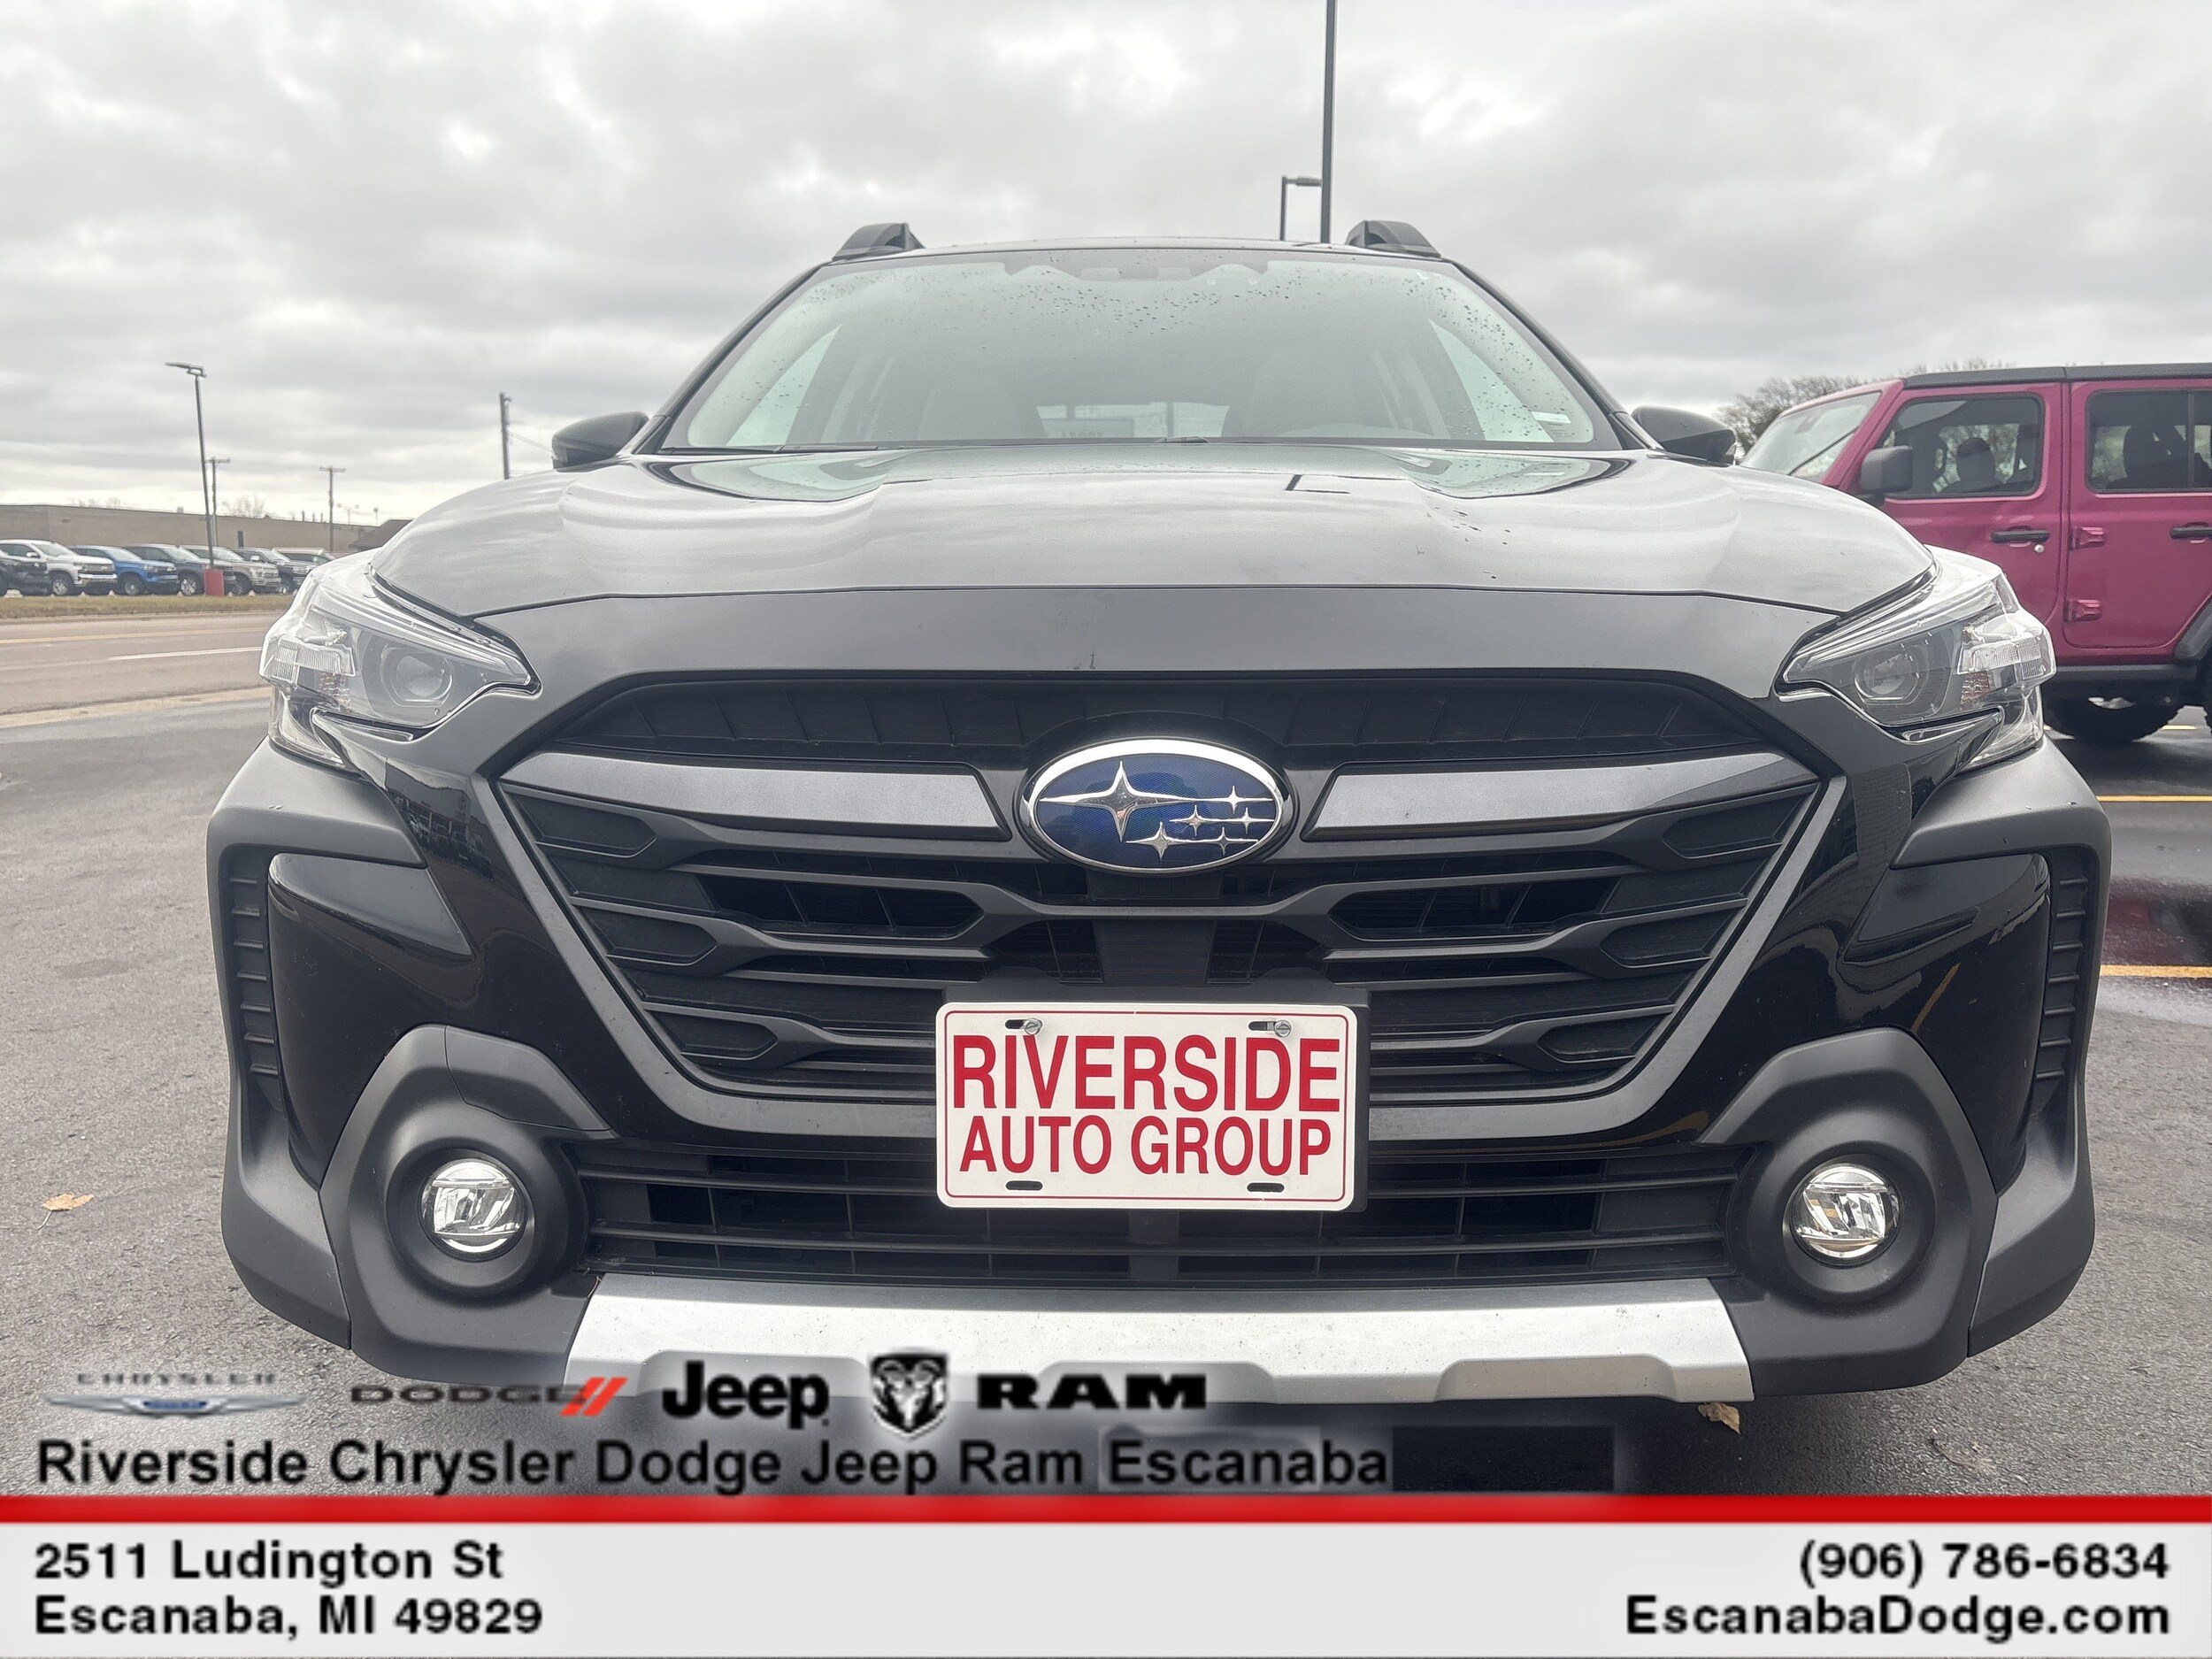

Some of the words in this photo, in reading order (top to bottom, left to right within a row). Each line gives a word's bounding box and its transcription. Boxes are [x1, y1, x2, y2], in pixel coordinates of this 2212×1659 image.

[953, 1034, 1340, 1112] RIVERSIDE
[959, 1115, 1112, 1174] AUTO
[1131, 1116, 1332, 1176] GROUP
